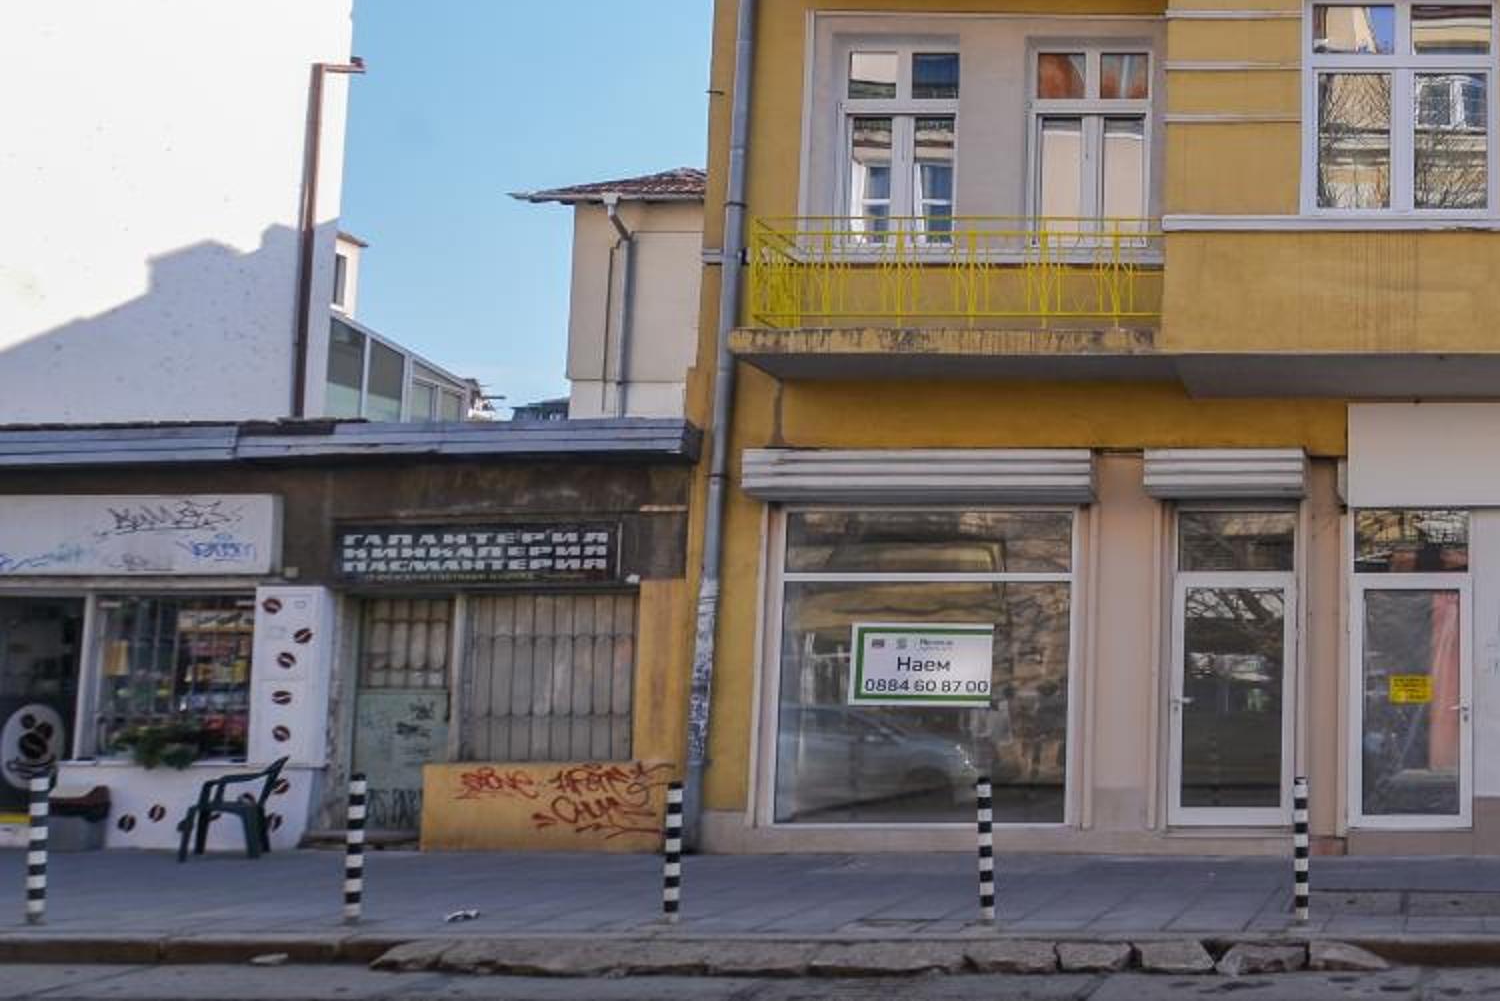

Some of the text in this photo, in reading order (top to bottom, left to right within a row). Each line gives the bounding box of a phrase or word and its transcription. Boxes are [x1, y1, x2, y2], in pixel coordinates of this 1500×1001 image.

[342, 532, 609, 546] ГАЛАНТЕРИЯ
[342, 557, 608, 573] ПАСМАНТЕРИЯ
[896, 656, 951, 672] Наем
[865, 678, 989, 693] 0884 60 87 00
